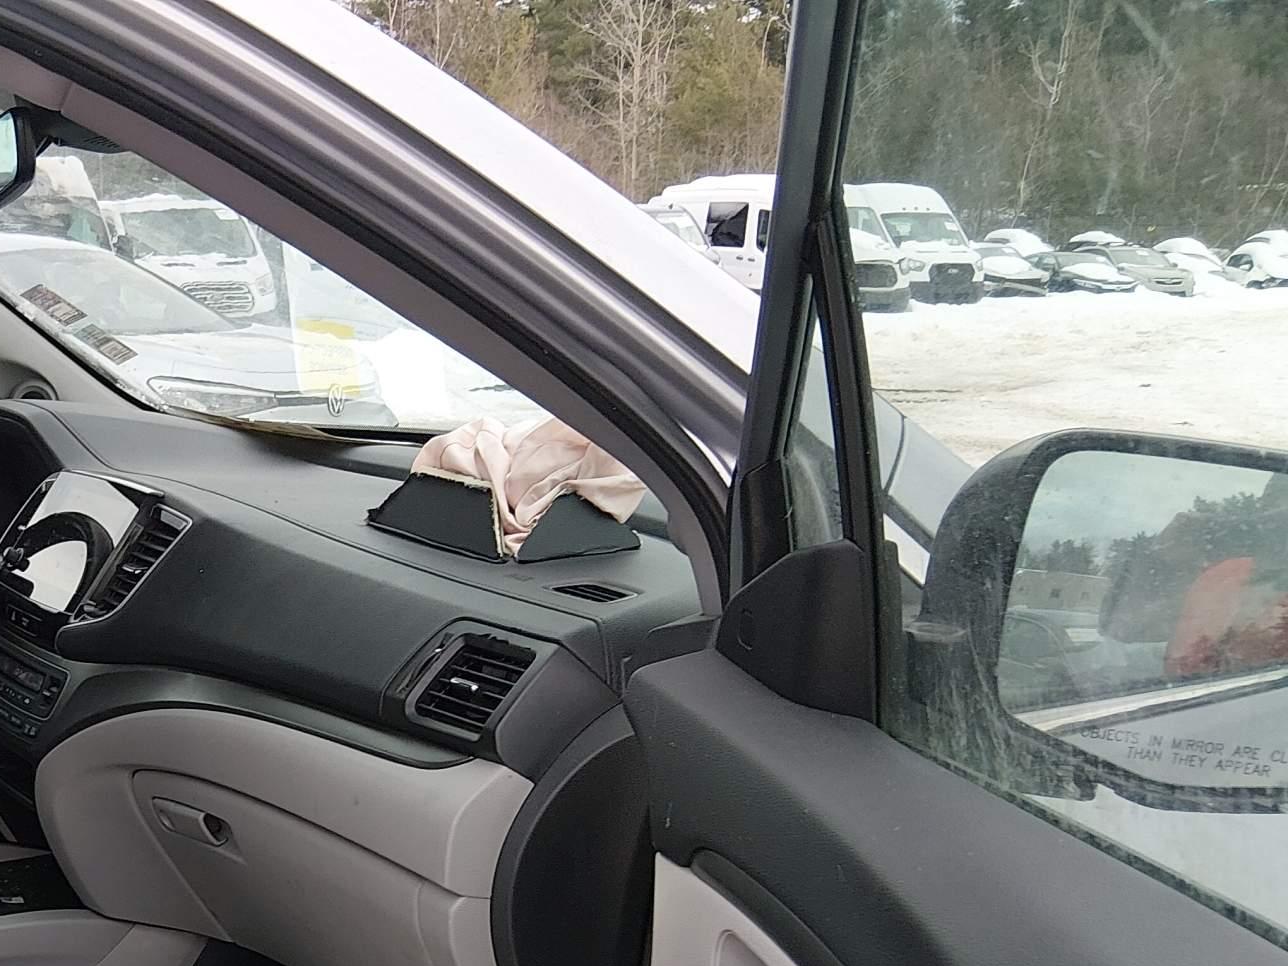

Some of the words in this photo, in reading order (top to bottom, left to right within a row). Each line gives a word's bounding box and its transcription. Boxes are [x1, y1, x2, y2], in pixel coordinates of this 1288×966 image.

[1080, 728, 1140, 745] OBJECTS
[1148, 735, 1163, 747] IN
[1170, 736, 1225, 754] MIRROR
[1231, 745, 1261, 761] ARE
[1127, 746, 1162, 761] THAN
[1171, 753, 1208, 768] THEY
[1215, 759, 1272, 777] APPEAR
